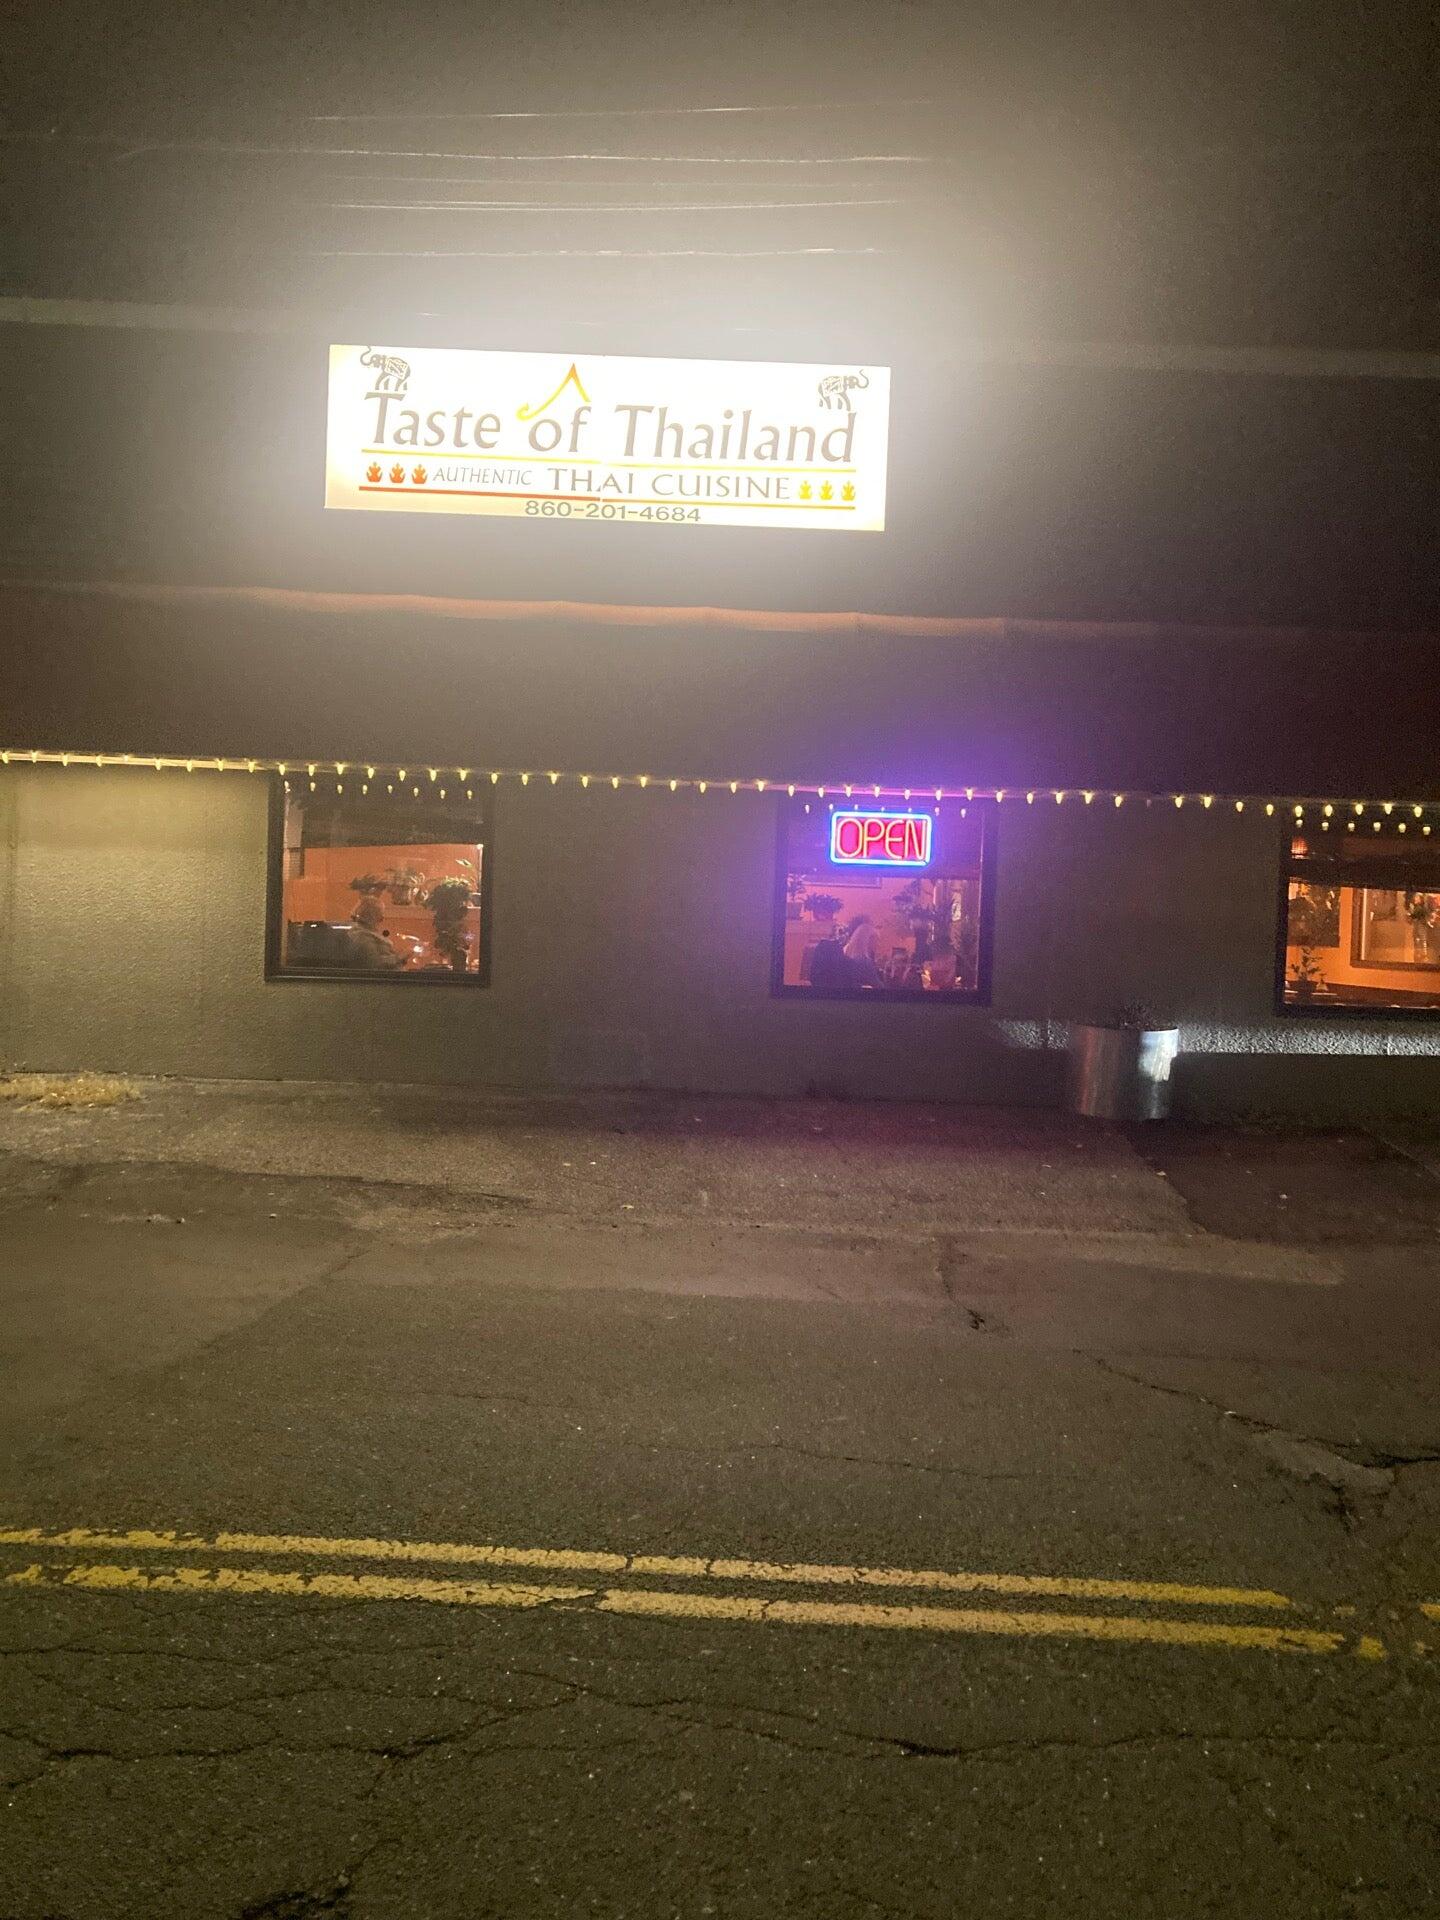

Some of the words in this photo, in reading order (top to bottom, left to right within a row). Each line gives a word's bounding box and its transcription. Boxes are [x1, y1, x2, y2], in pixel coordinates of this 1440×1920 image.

[365, 392, 501, 449] Taste
[529, 406, 591, 453] of
[615, 404, 857, 463] Thailand
[433, 467, 532, 486] AUTHENTIC
[548, 467, 634, 494] THAI
[651, 474, 790, 499] CUISINE
[525, 500, 701, 521] 860-201-4684
[837, 818, 926, 859] OPEN
